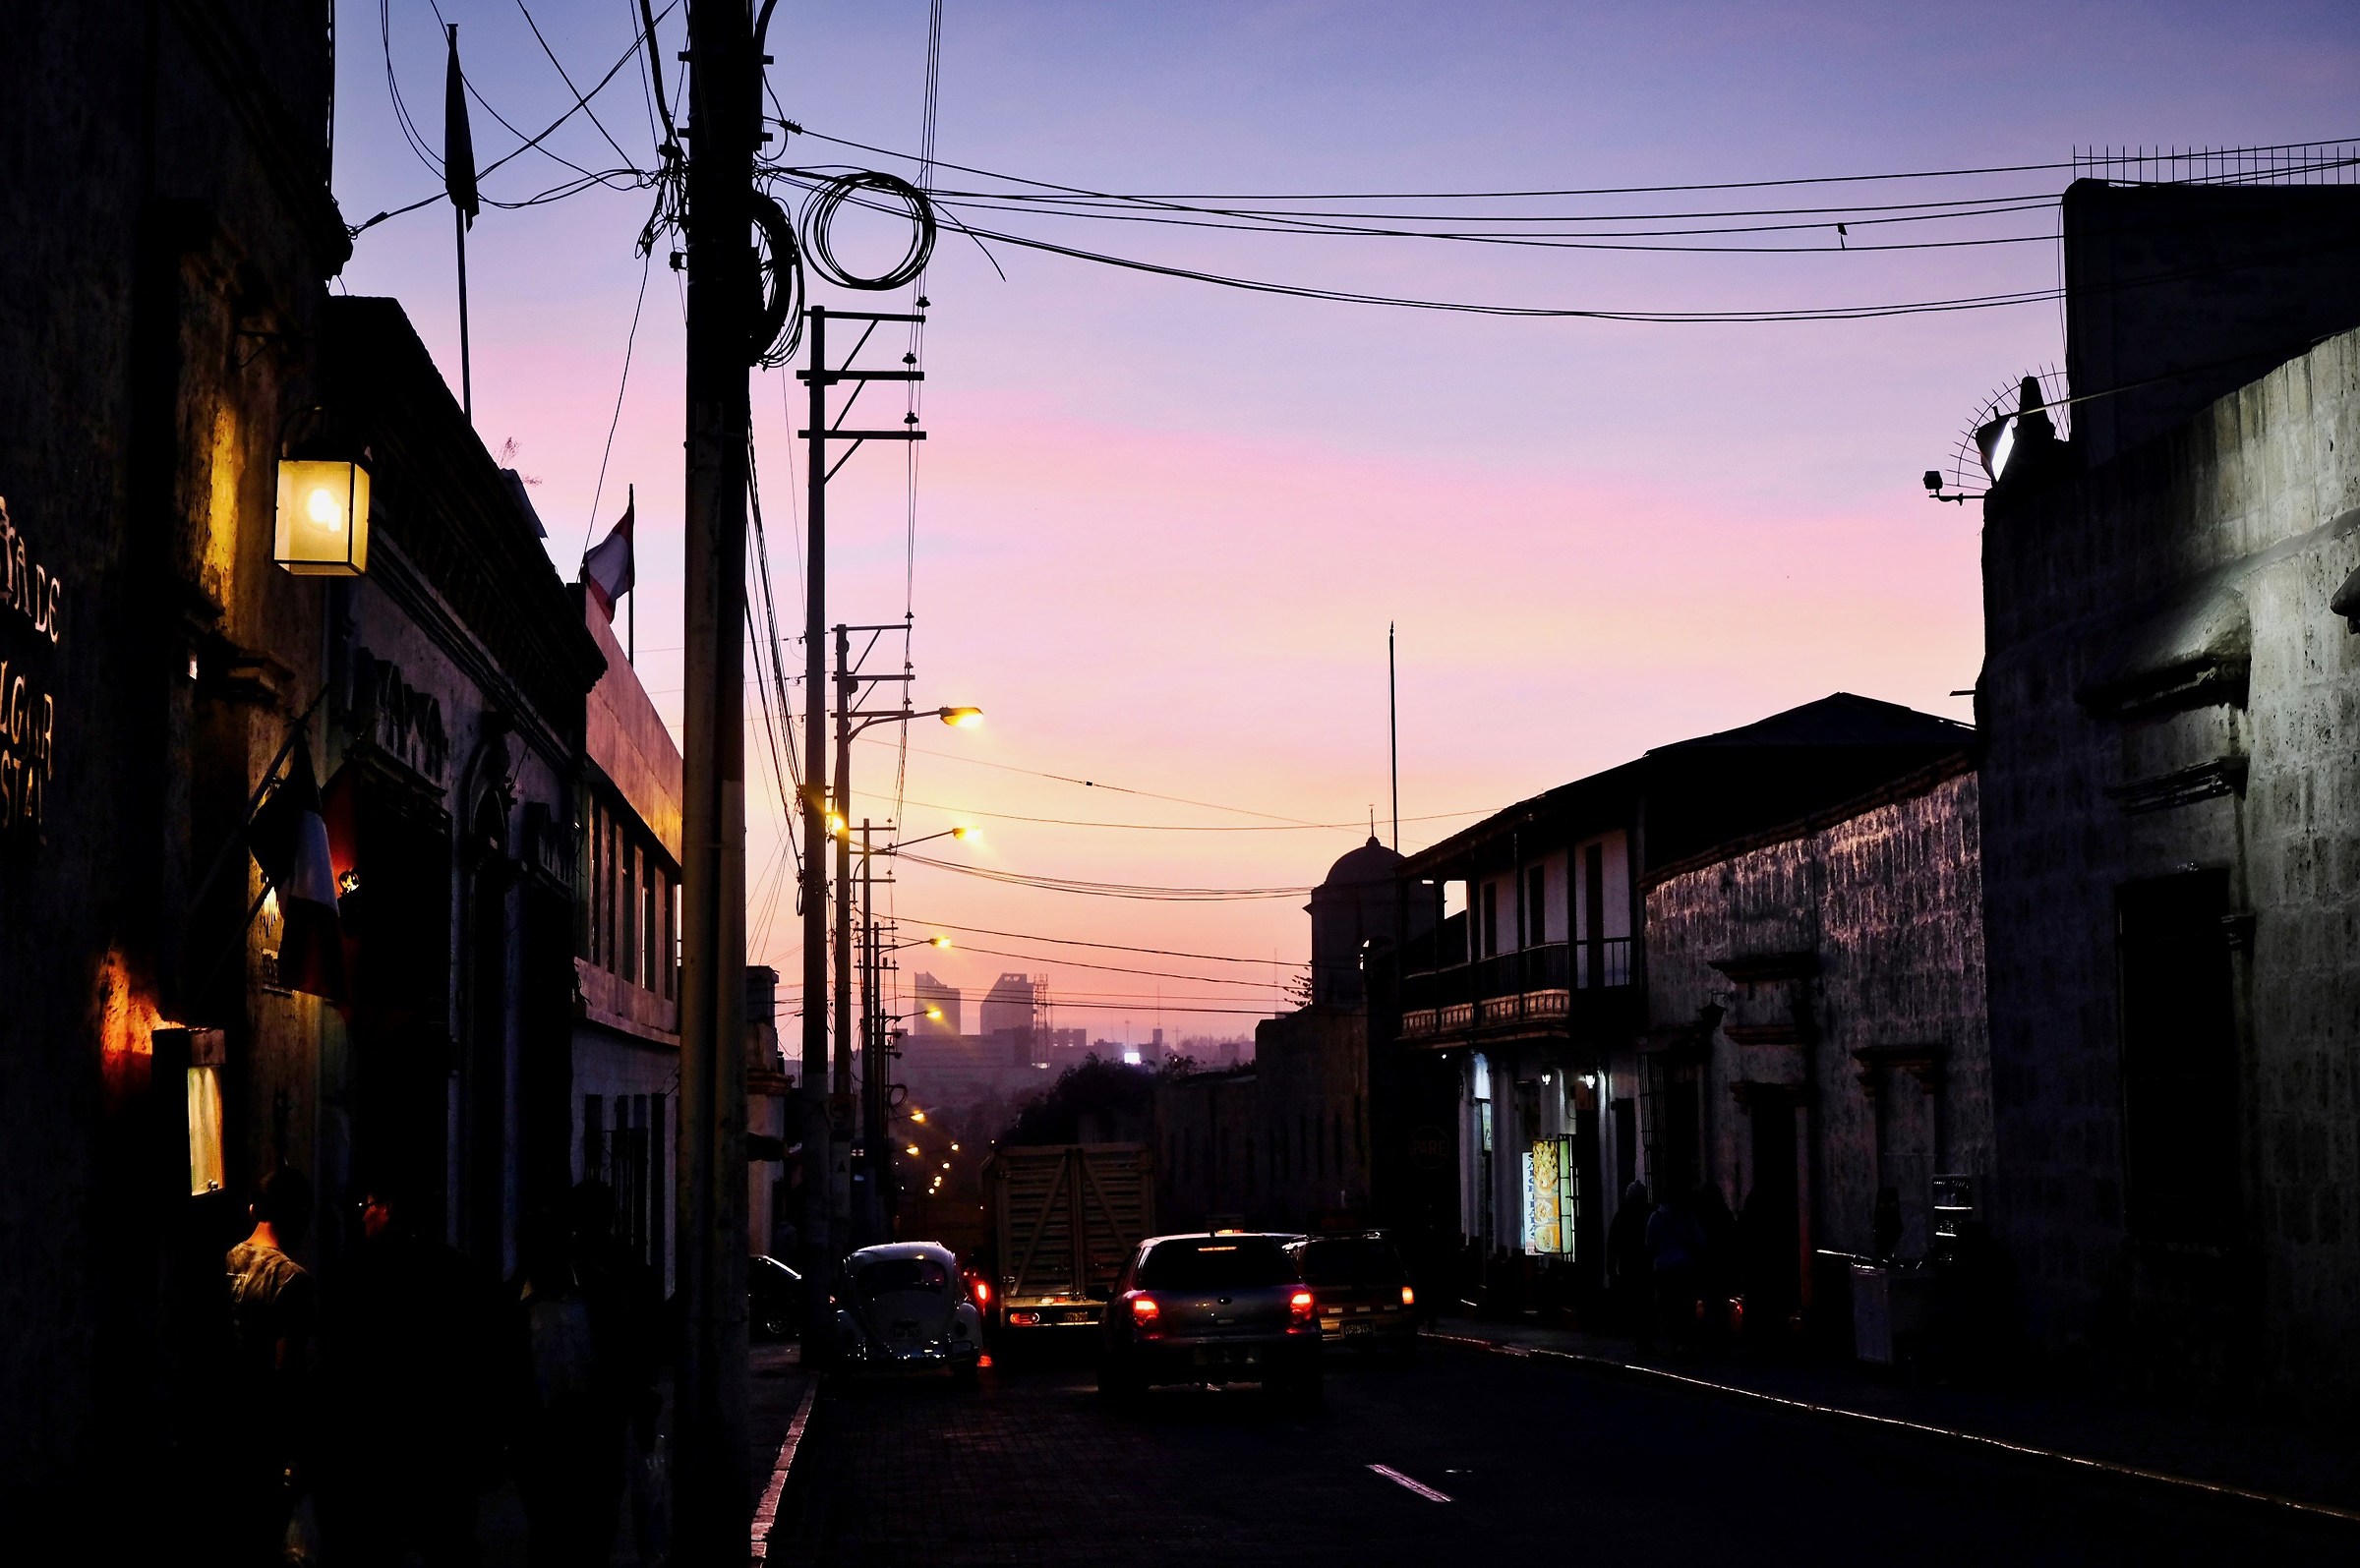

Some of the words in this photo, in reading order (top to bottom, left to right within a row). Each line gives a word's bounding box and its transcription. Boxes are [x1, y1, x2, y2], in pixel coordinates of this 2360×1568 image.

[35, 563, 61, 644] DE
[0, 660, 54, 783] LGAR
[1412, 1139, 1448, 1157] PARE
